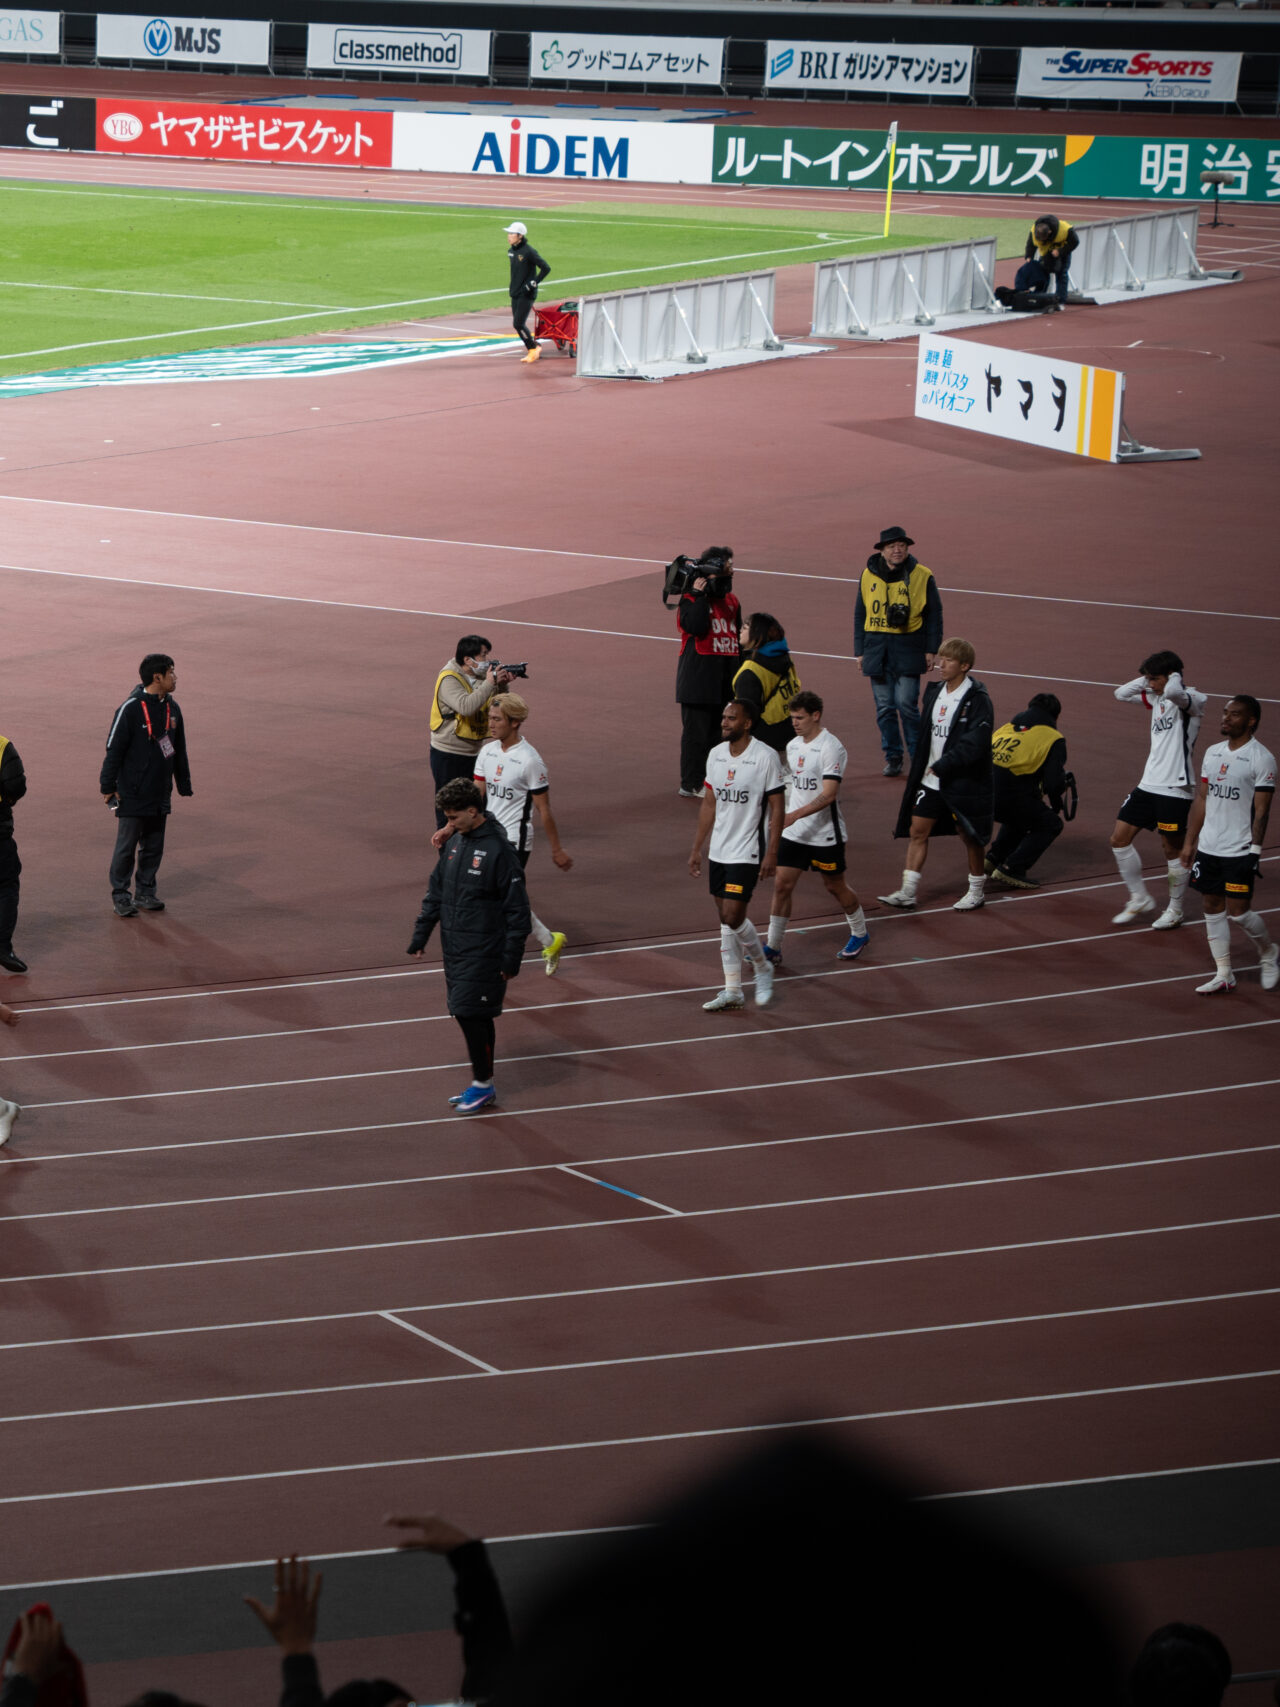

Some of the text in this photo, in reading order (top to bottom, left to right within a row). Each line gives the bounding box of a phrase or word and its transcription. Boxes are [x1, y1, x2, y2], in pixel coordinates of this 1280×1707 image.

[175, 26, 222, 54] MJS
[339, 40, 456, 63] classmethod
[567, 48, 710, 74] グッドコムアセット
[798, 51, 968, 84] BRI ガリシアマンション
[1046, 51, 1215, 76] THE SUPER SPORTS
[111, 118, 136, 136] YBC
[150, 112, 374, 158] ヤマザキビスケット
[718, 137, 1059, 189] ルートインホテルズ
[716, 788, 750, 804] POLUS
[1207, 783, 1241, 801] POLUS
